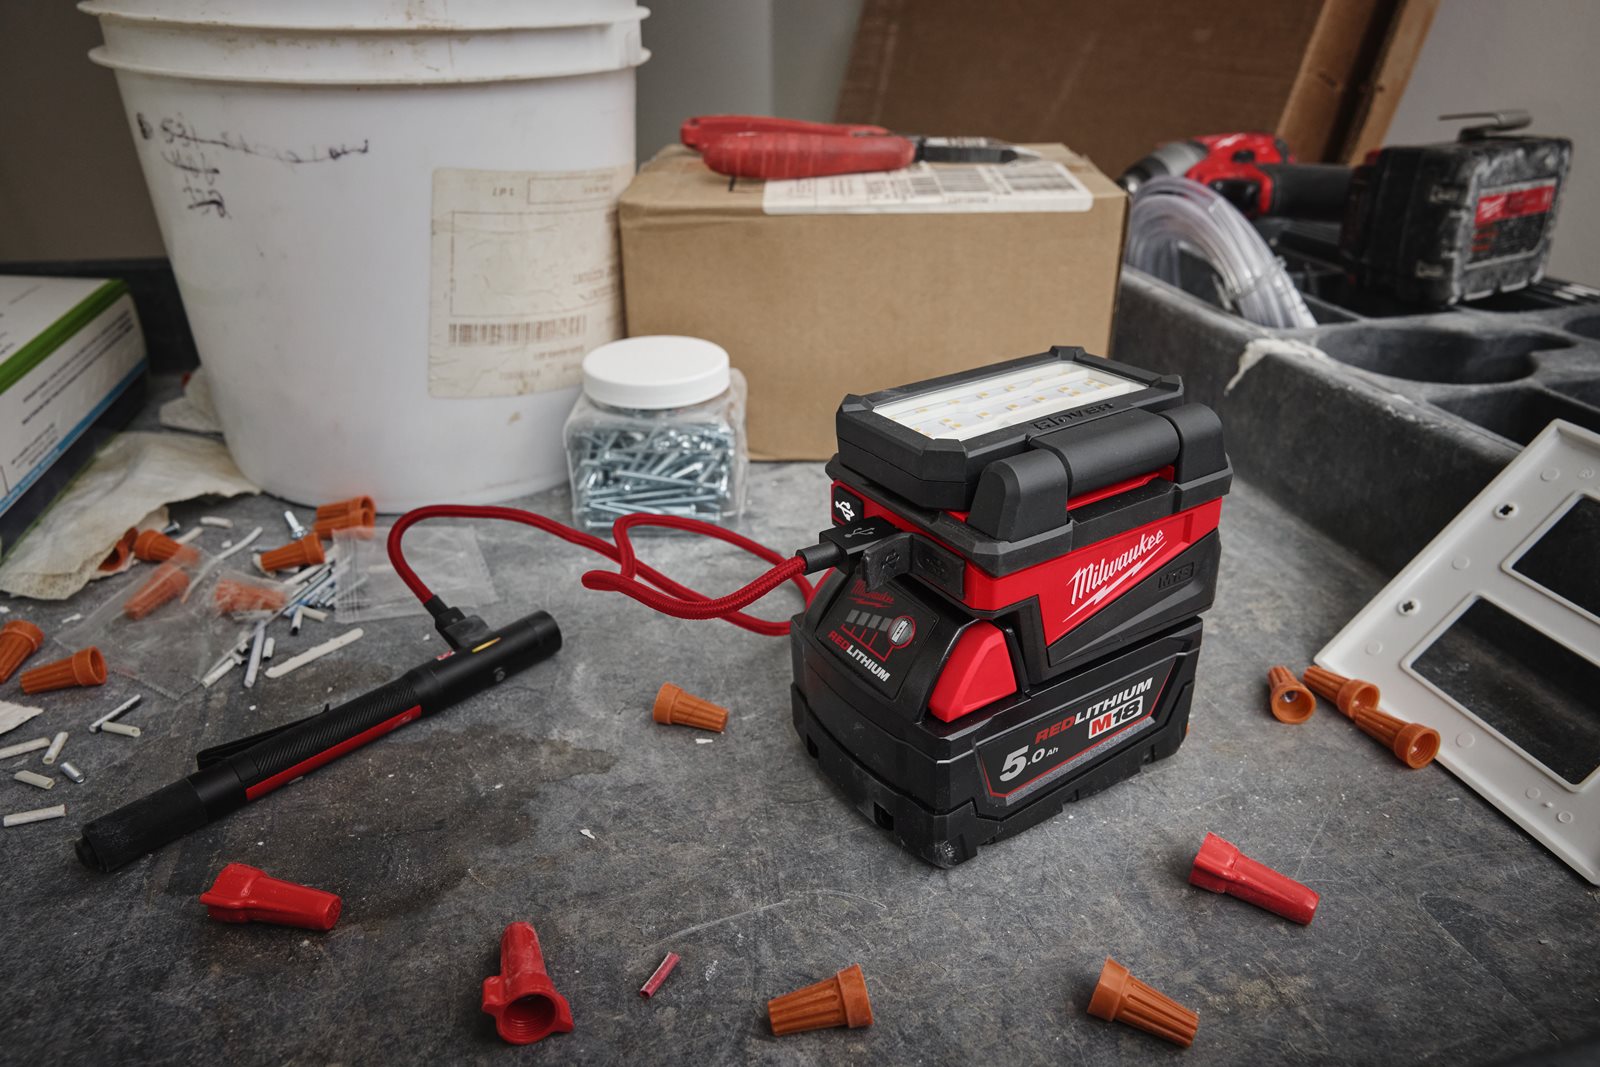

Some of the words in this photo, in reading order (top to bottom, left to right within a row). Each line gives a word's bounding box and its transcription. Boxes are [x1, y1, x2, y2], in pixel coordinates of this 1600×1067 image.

[1066, 529, 1164, 605] Milwaukee
[828, 630, 891, 682] REDLITHIUM
[1034, 676, 1153, 745] REDLITHIUM
[1090, 698, 1141, 737] M18
[999, 745, 1046, 782] 5.0
[1045, 746, 1059, 758] Ah
